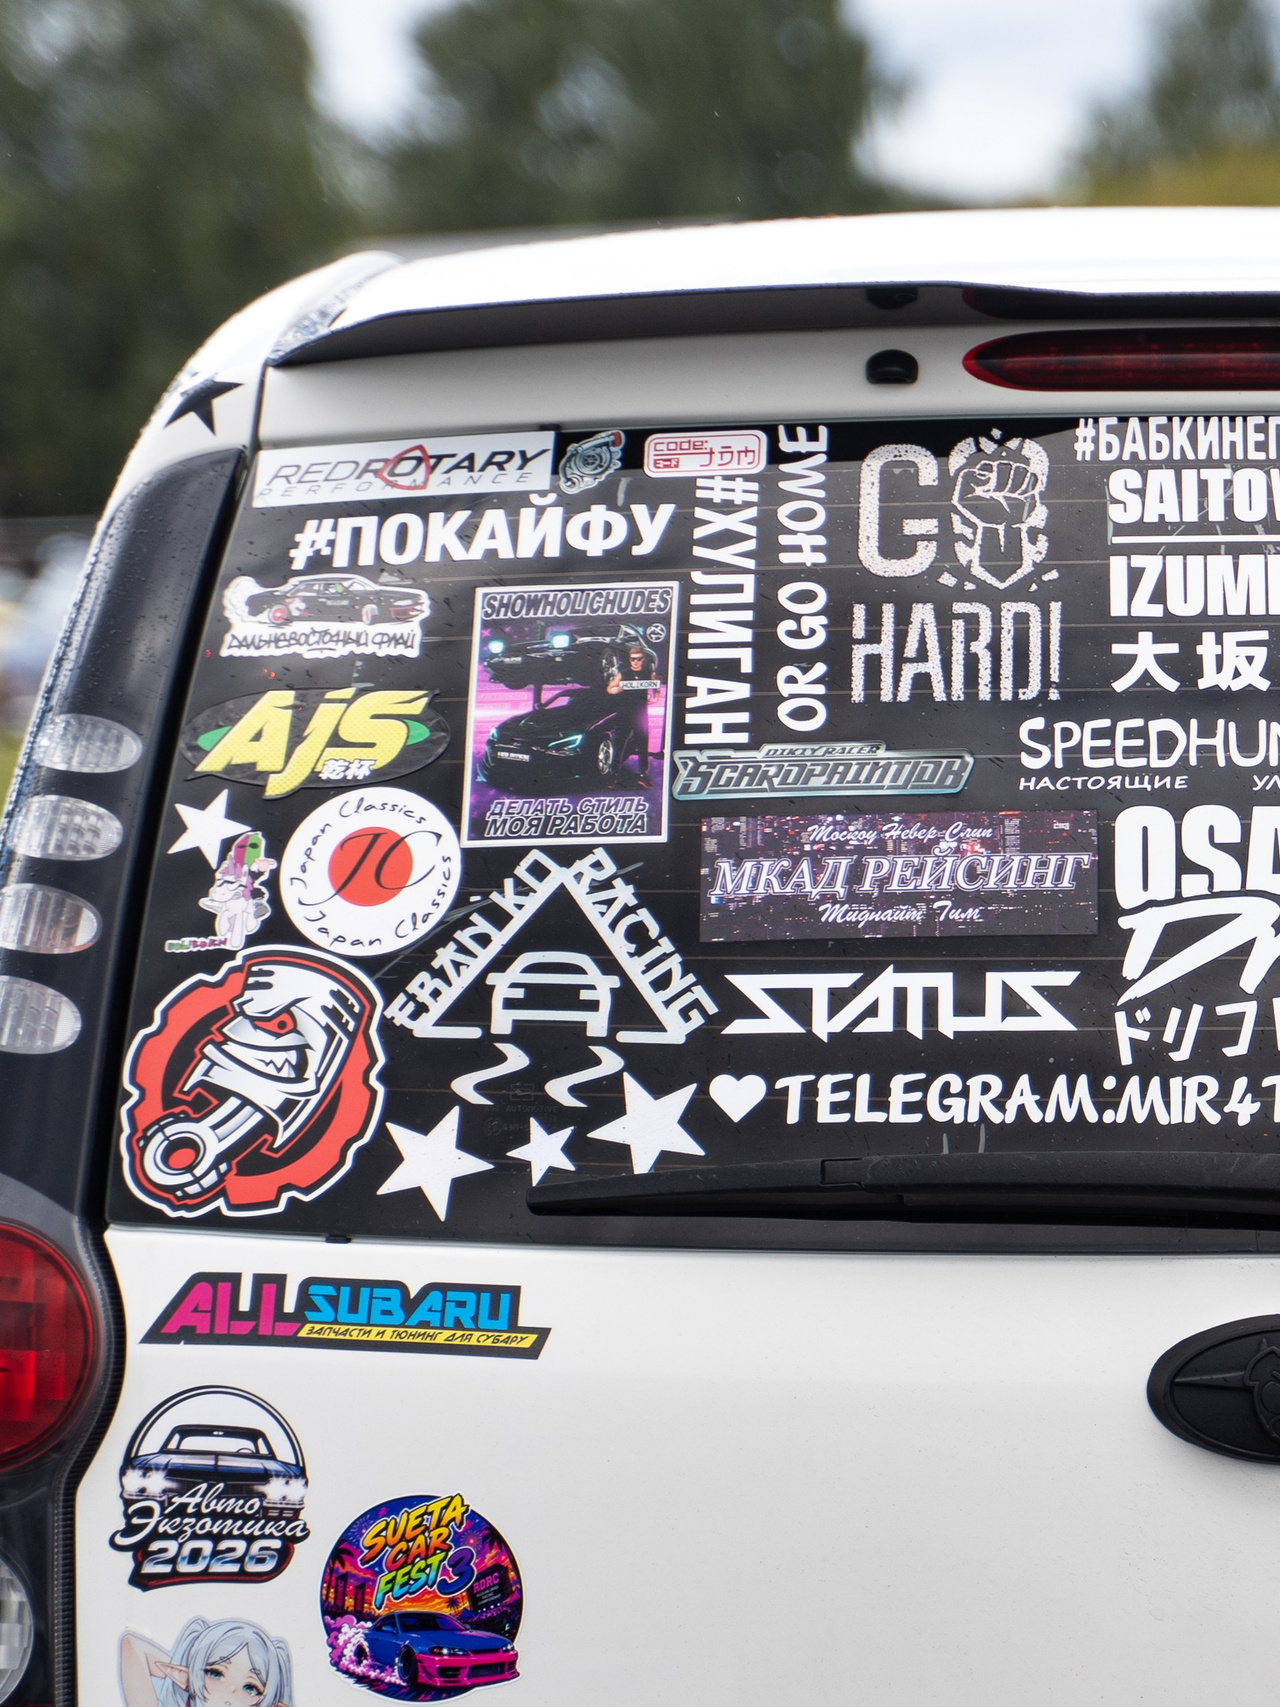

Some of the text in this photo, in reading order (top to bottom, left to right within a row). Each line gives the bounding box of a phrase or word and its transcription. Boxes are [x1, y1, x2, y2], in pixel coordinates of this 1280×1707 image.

[289, 493, 676, 570] #ПОКАЙФУ
[776, 424, 828, 731] OR GO HOME
[684, 475, 759, 744] #ХУЛИГАН
[851, 601, 1061, 702] HARD!
[319, 758, 377, 780] 乾杯
[1018, 774, 1189, 792] НАСТОЯЩИЕ
[485, 814, 648, 837] МОЯ РАБОТА
[486, 797, 649, 821] ДЕЛАТЬ СТИЛЬ
[943, 821, 993, 842] Слип
[290, 797, 427, 889] Japan Classics
[707, 846, 1093, 901] МКАД РЕЙСИНГ
[304, 855, 452, 947] Japan Classics
[931, 900, 982, 922] Тим
[568, 846, 719, 1035] RACING
[720, 964, 1081, 1043] STATUS
[161, 1281, 512, 1335] ALL SUBARU
[306, 1326, 529, 1345] ЗАПЧАСТИ И ТЮНИНГ ДЛЯ СУБАРУ
[114, 1500, 310, 1546] Экзотика
[359, 1494, 469, 1566] SUETA
[385, 1526, 452, 1572] CAR
[140, 1539, 283, 1574] 2026
[374, 1551, 446, 1609] FEST
[436, 1548, 475, 1596] 3
[473, 1572, 500, 1594] RDRC
